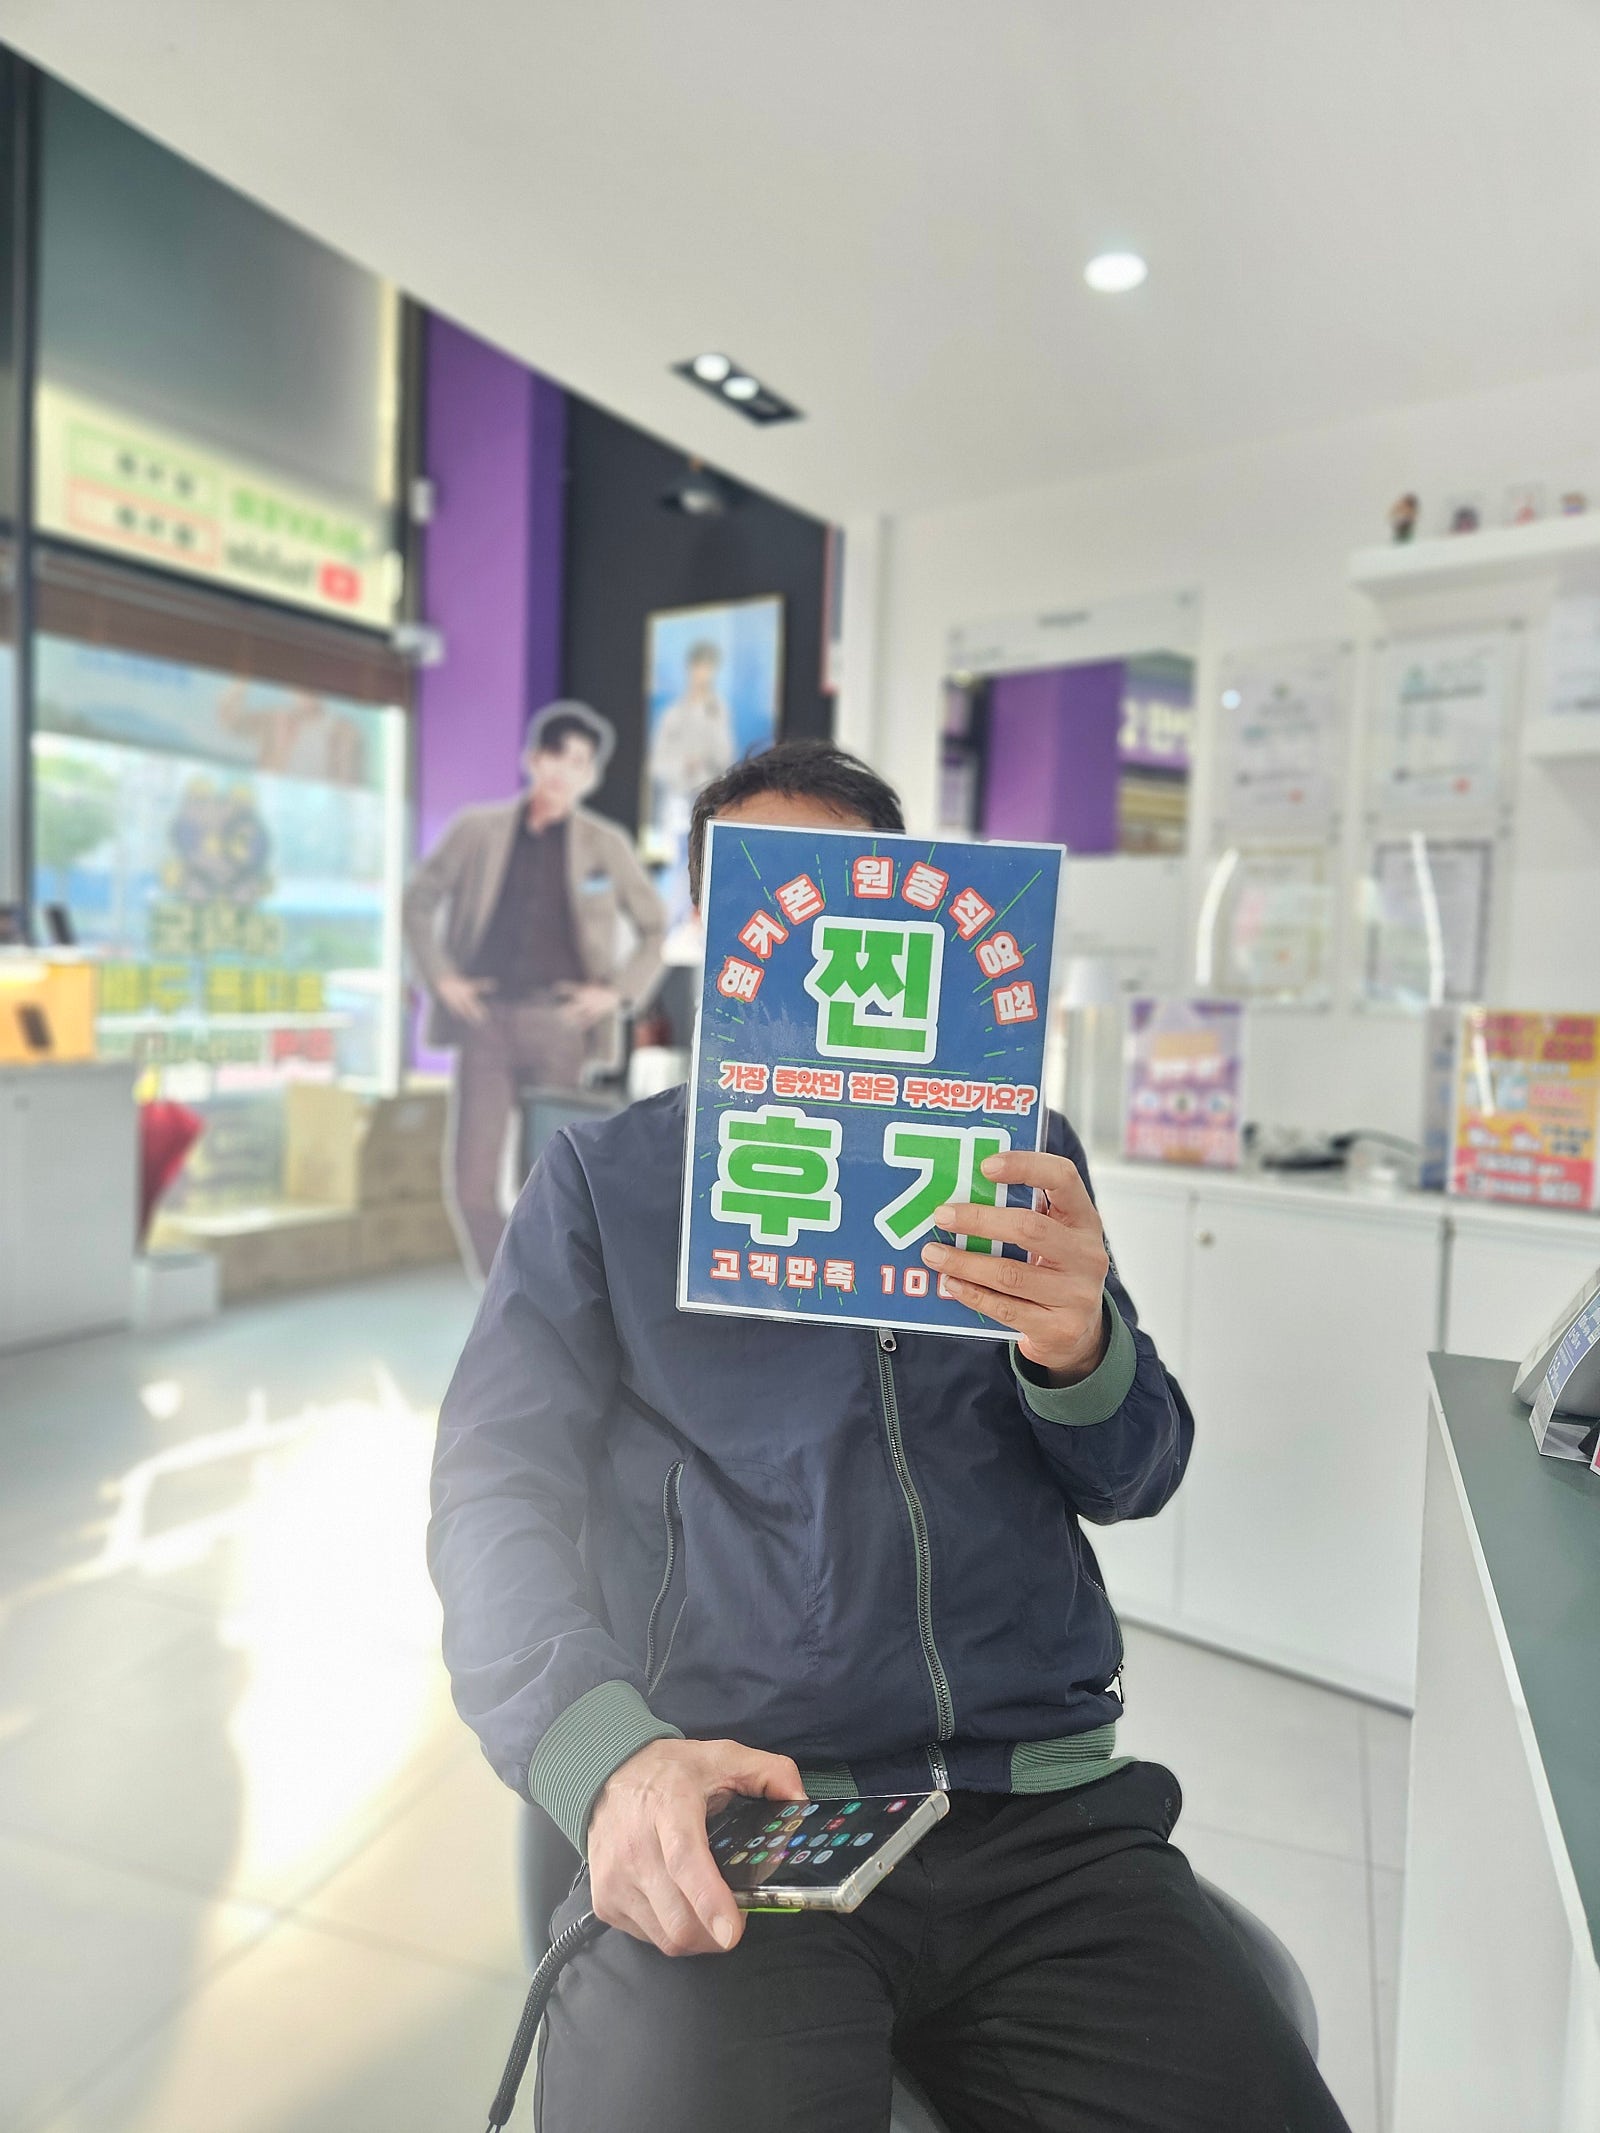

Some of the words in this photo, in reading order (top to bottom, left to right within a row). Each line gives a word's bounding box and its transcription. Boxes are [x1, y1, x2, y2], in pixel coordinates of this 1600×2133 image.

[718, 875, 824, 1001] 옆커폰
[854, 857, 1036, 1023] 원종직영점
[810, 924, 940, 1057] 찐
[720, 1063, 767, 1092] 가장
[774, 1067, 842, 1098] 좋았던
[850, 1072, 897, 1103] 점은
[904, 1077, 1036, 1112] 무엇인가요?
[711, 1250, 854, 1291] 고객만족
